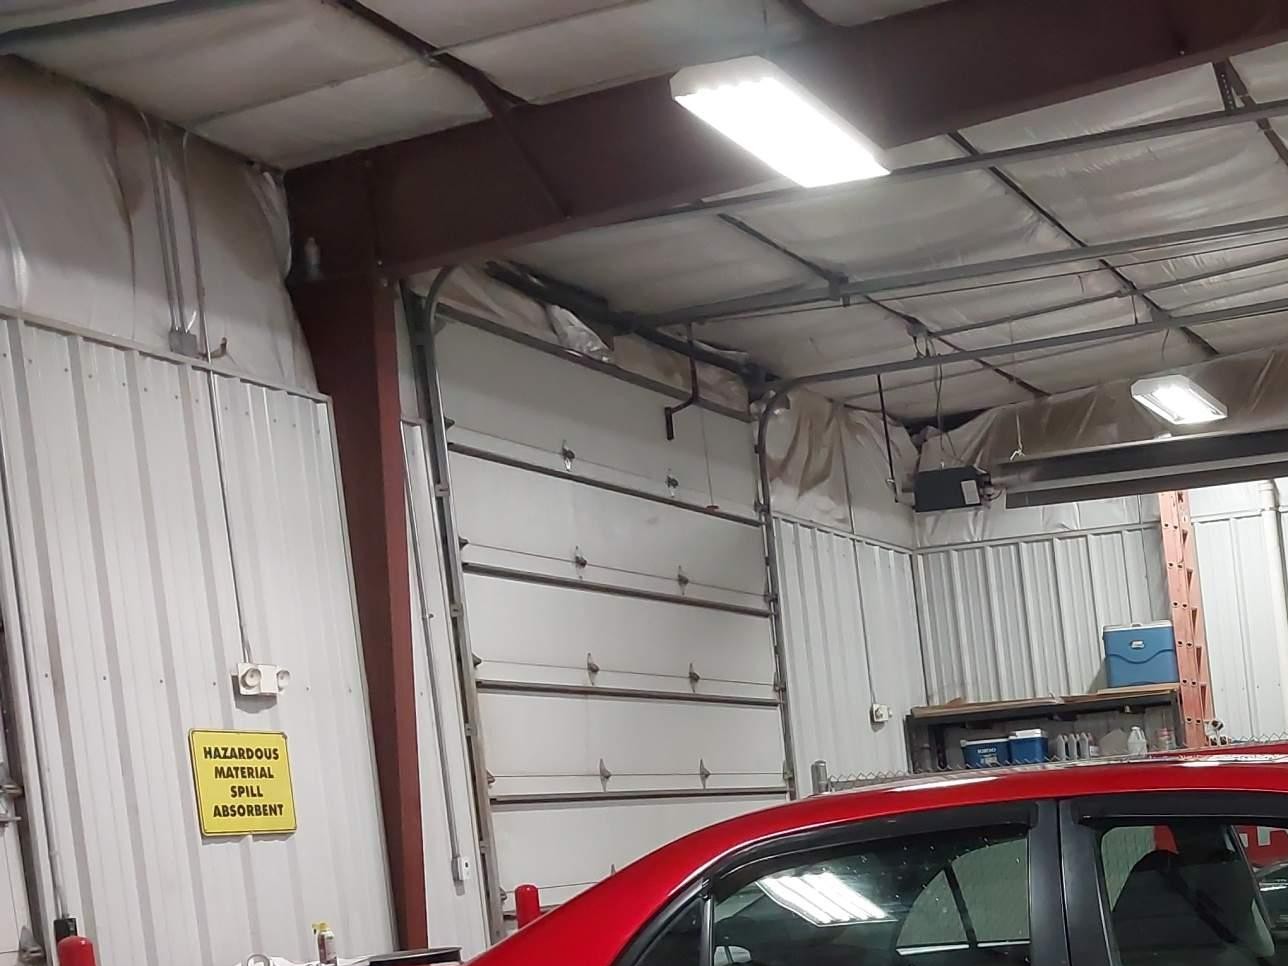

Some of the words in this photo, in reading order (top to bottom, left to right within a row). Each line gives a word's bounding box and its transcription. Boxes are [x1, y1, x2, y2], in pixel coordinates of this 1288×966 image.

[203, 747, 280, 760] HAZARDOUS
[214, 766, 274, 779] MATERIAL
[230, 785, 263, 798] SPILL
[213, 804, 284, 817] ABSORBENT
